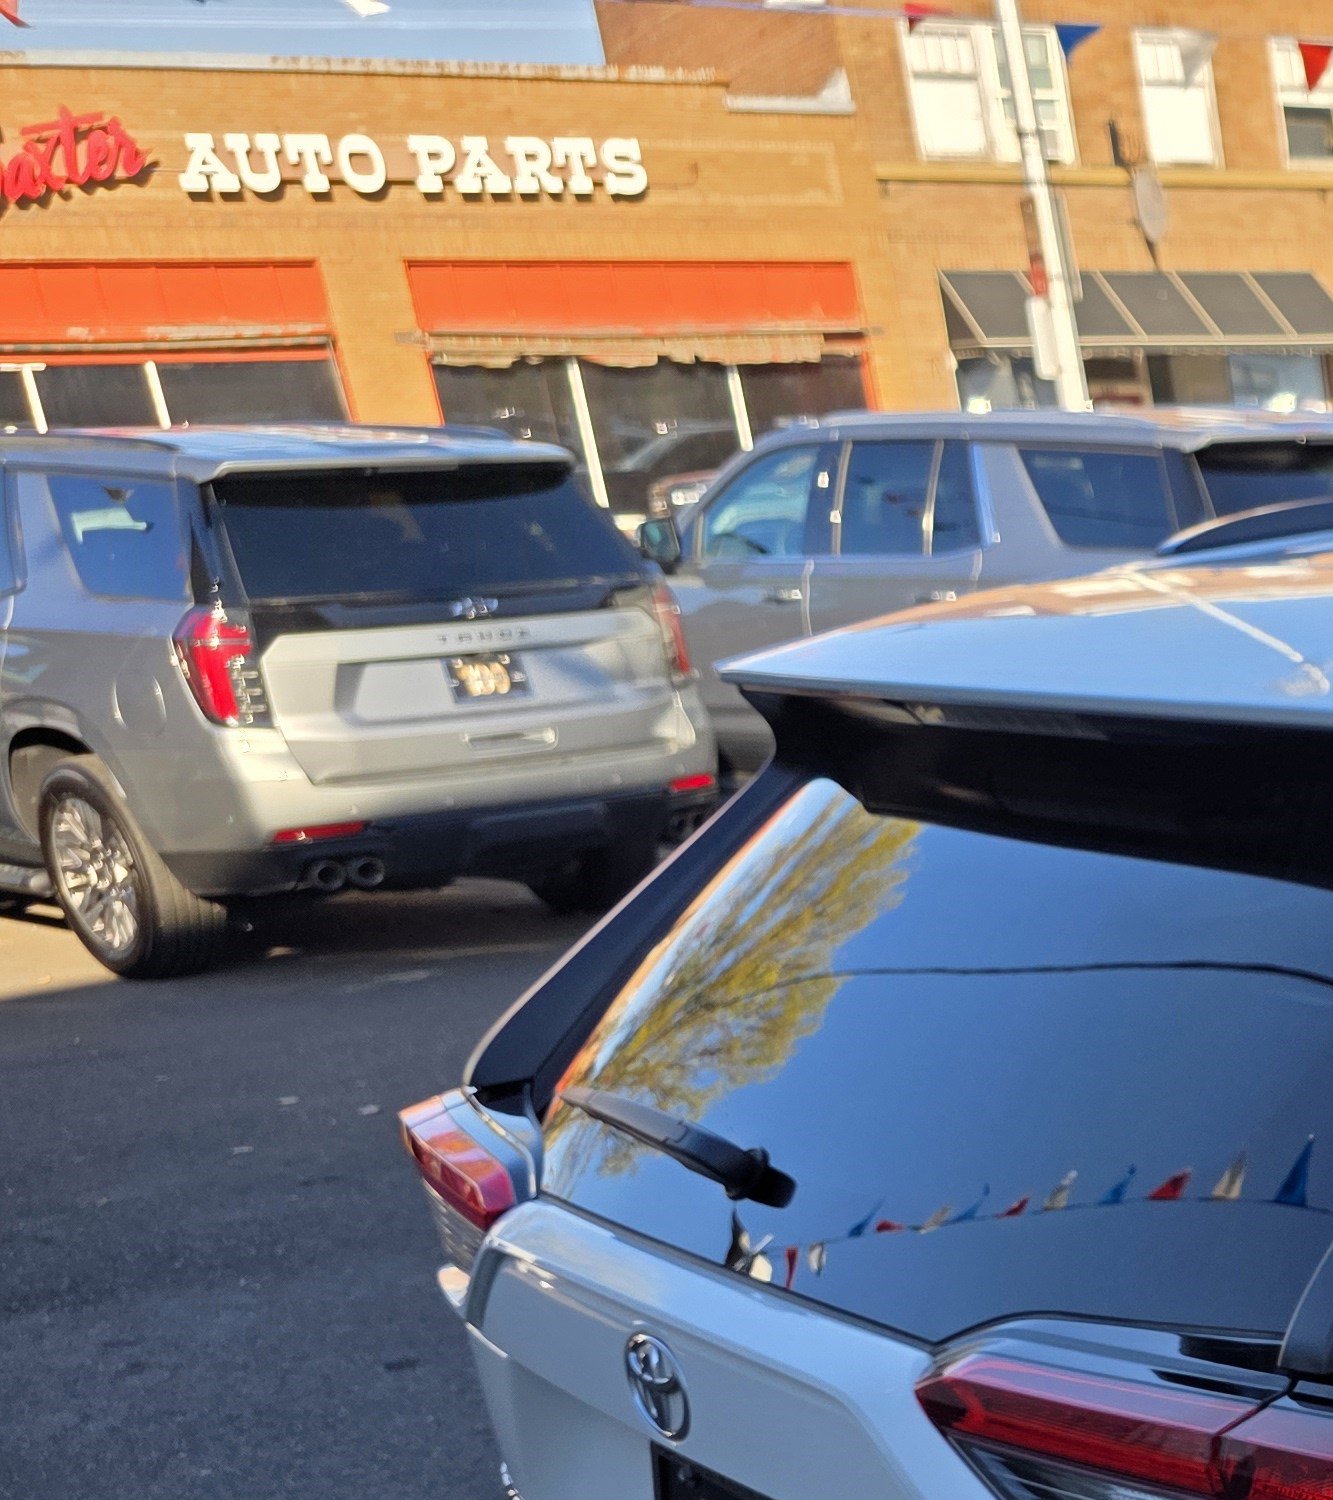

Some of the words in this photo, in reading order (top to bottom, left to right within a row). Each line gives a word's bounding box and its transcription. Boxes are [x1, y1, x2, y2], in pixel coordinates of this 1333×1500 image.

[0, 103, 150, 200] axter
[178, 132, 386, 194] AUTO
[407, 134, 648, 196] PARTS
